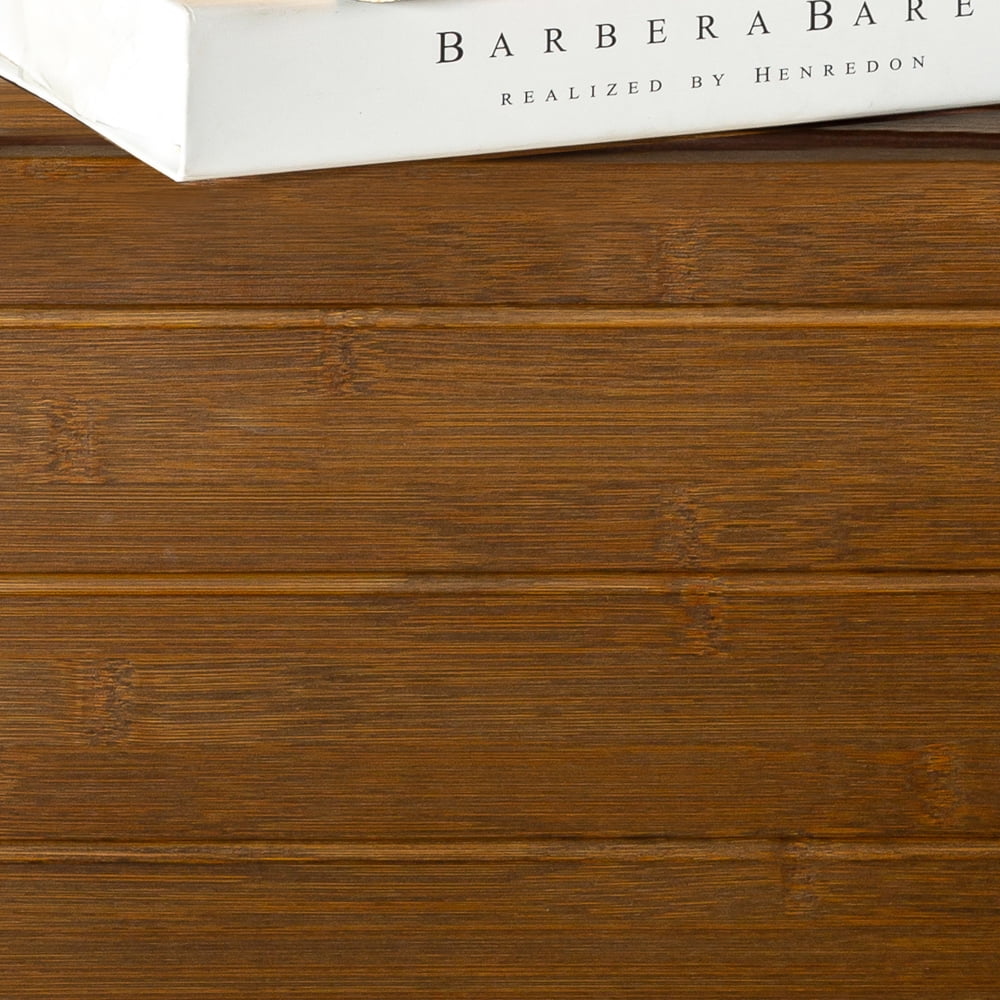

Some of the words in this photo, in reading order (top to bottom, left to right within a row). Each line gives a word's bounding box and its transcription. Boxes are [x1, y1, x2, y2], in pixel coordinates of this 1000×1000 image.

[436, 10, 771, 64] BARBERA
[501, 79, 662, 106] REALIZED
[692, 73, 726, 89] BY
[754, 54, 928, 83] HENREDON
